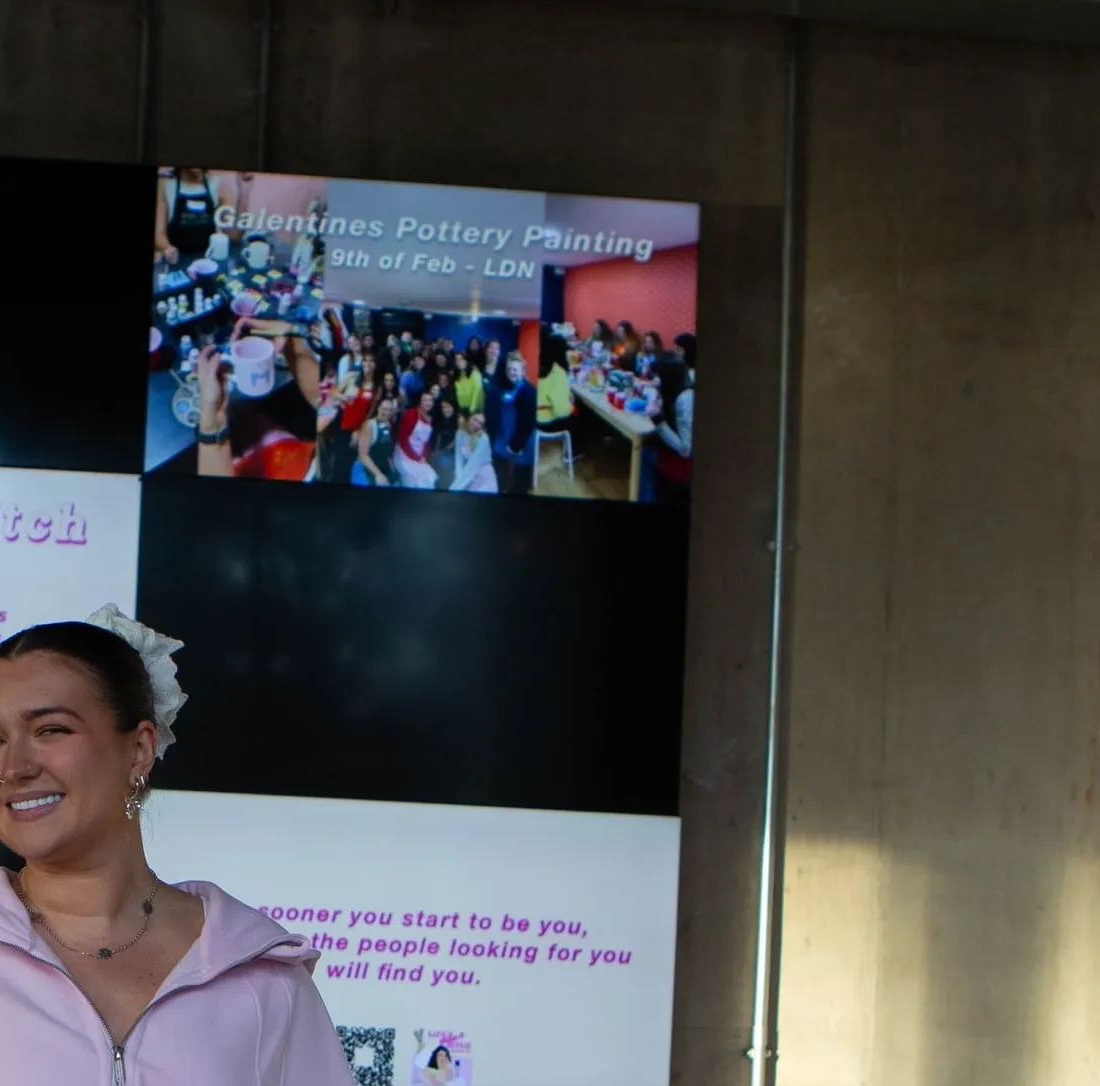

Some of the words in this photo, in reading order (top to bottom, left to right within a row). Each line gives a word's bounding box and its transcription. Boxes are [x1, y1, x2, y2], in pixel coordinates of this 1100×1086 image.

[214, 205, 384, 237] Galentines
[396, 216, 512, 250] Pottery
[523, 225, 653, 263] Painting
[331, 248, 369, 268] 9th
[379, 252, 404, 270] of
[411, 253, 456, 273] Feb
[483, 258, 535, 278] LDN
[348, 910, 393, 928] you
[402, 910, 460, 928] start
[469, 913, 492, 930] to
[501, 914, 530, 932] be
[538, 919, 588, 938] you,
[311, 932, 349, 950] the
[357, 936, 440, 957] people
[449, 938, 538, 964] looking
[548, 943, 583, 961] for
[588, 949, 632, 967] you
[327, 961, 369, 979] will
[377, 963, 424, 982] find
[430, 969, 481, 986] you.
